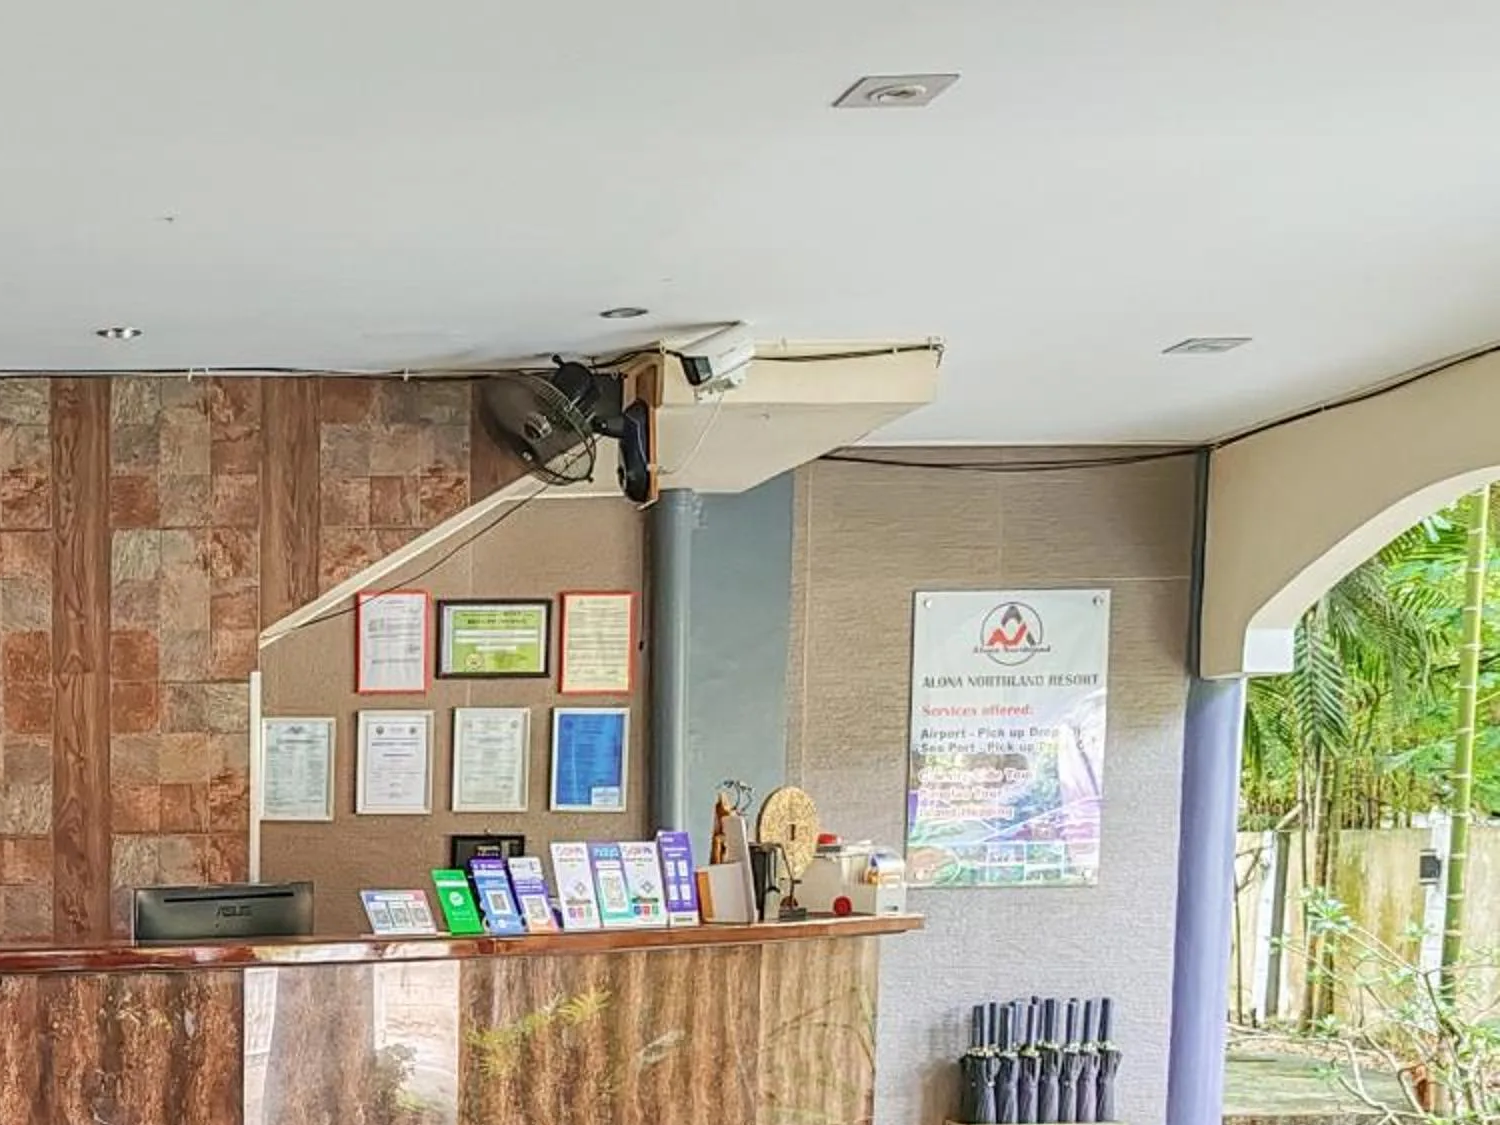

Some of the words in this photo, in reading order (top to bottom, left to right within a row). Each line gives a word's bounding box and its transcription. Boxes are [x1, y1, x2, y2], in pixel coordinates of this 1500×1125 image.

[922, 675, 963, 688] ALONA
[967, 674, 1044, 688] NORTHLAND
[1048, 673, 1099, 687] RESORT
[921, 704, 977, 717] Services
[980, 703, 1034, 716] offered:
[920, 727, 966, 740] Airport
[977, 727, 1005, 738] Pick
[1009, 730, 1024, 739] up
[950, 742, 975, 752] Port
[987, 742, 1014, 752] Pick
[216, 905, 252, 917] ASUS
